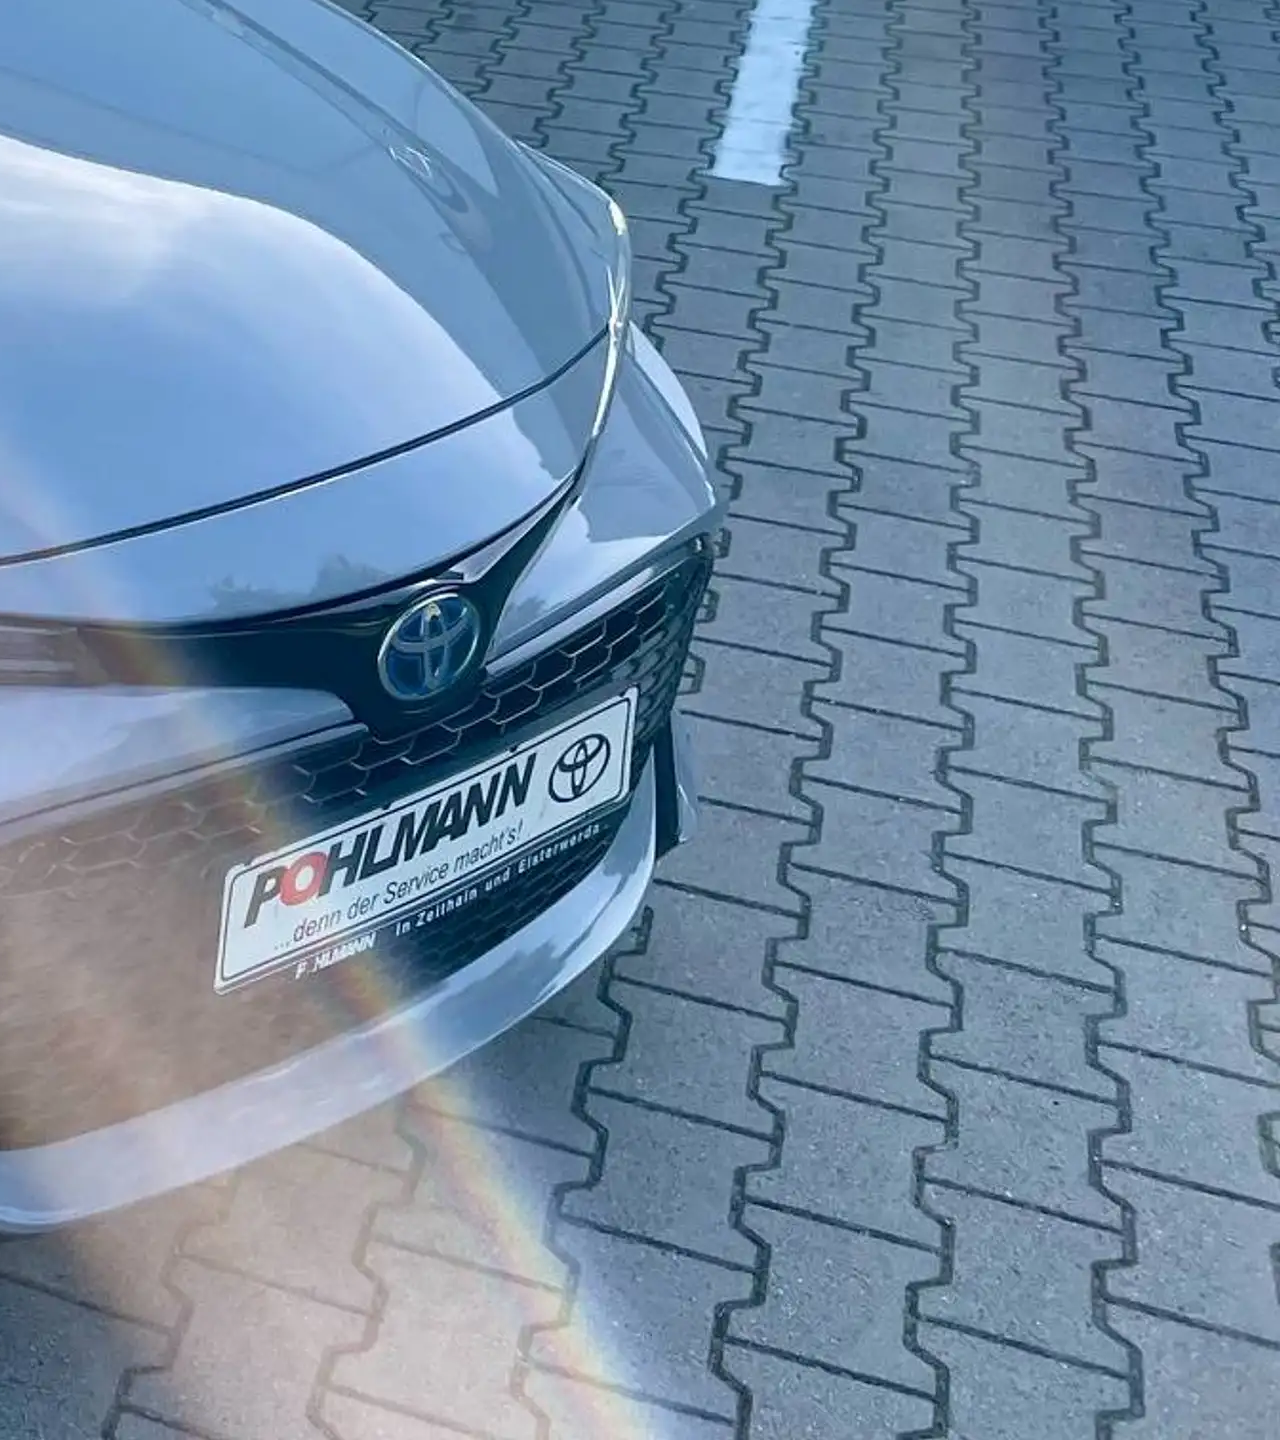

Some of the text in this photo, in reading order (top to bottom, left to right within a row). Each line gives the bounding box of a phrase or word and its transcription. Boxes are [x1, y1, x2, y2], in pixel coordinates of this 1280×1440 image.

[347, 892, 381, 920] der
[383, 861, 449, 905] Service
[453, 818, 525, 873] macht's!
[485, 867, 511, 892] und
